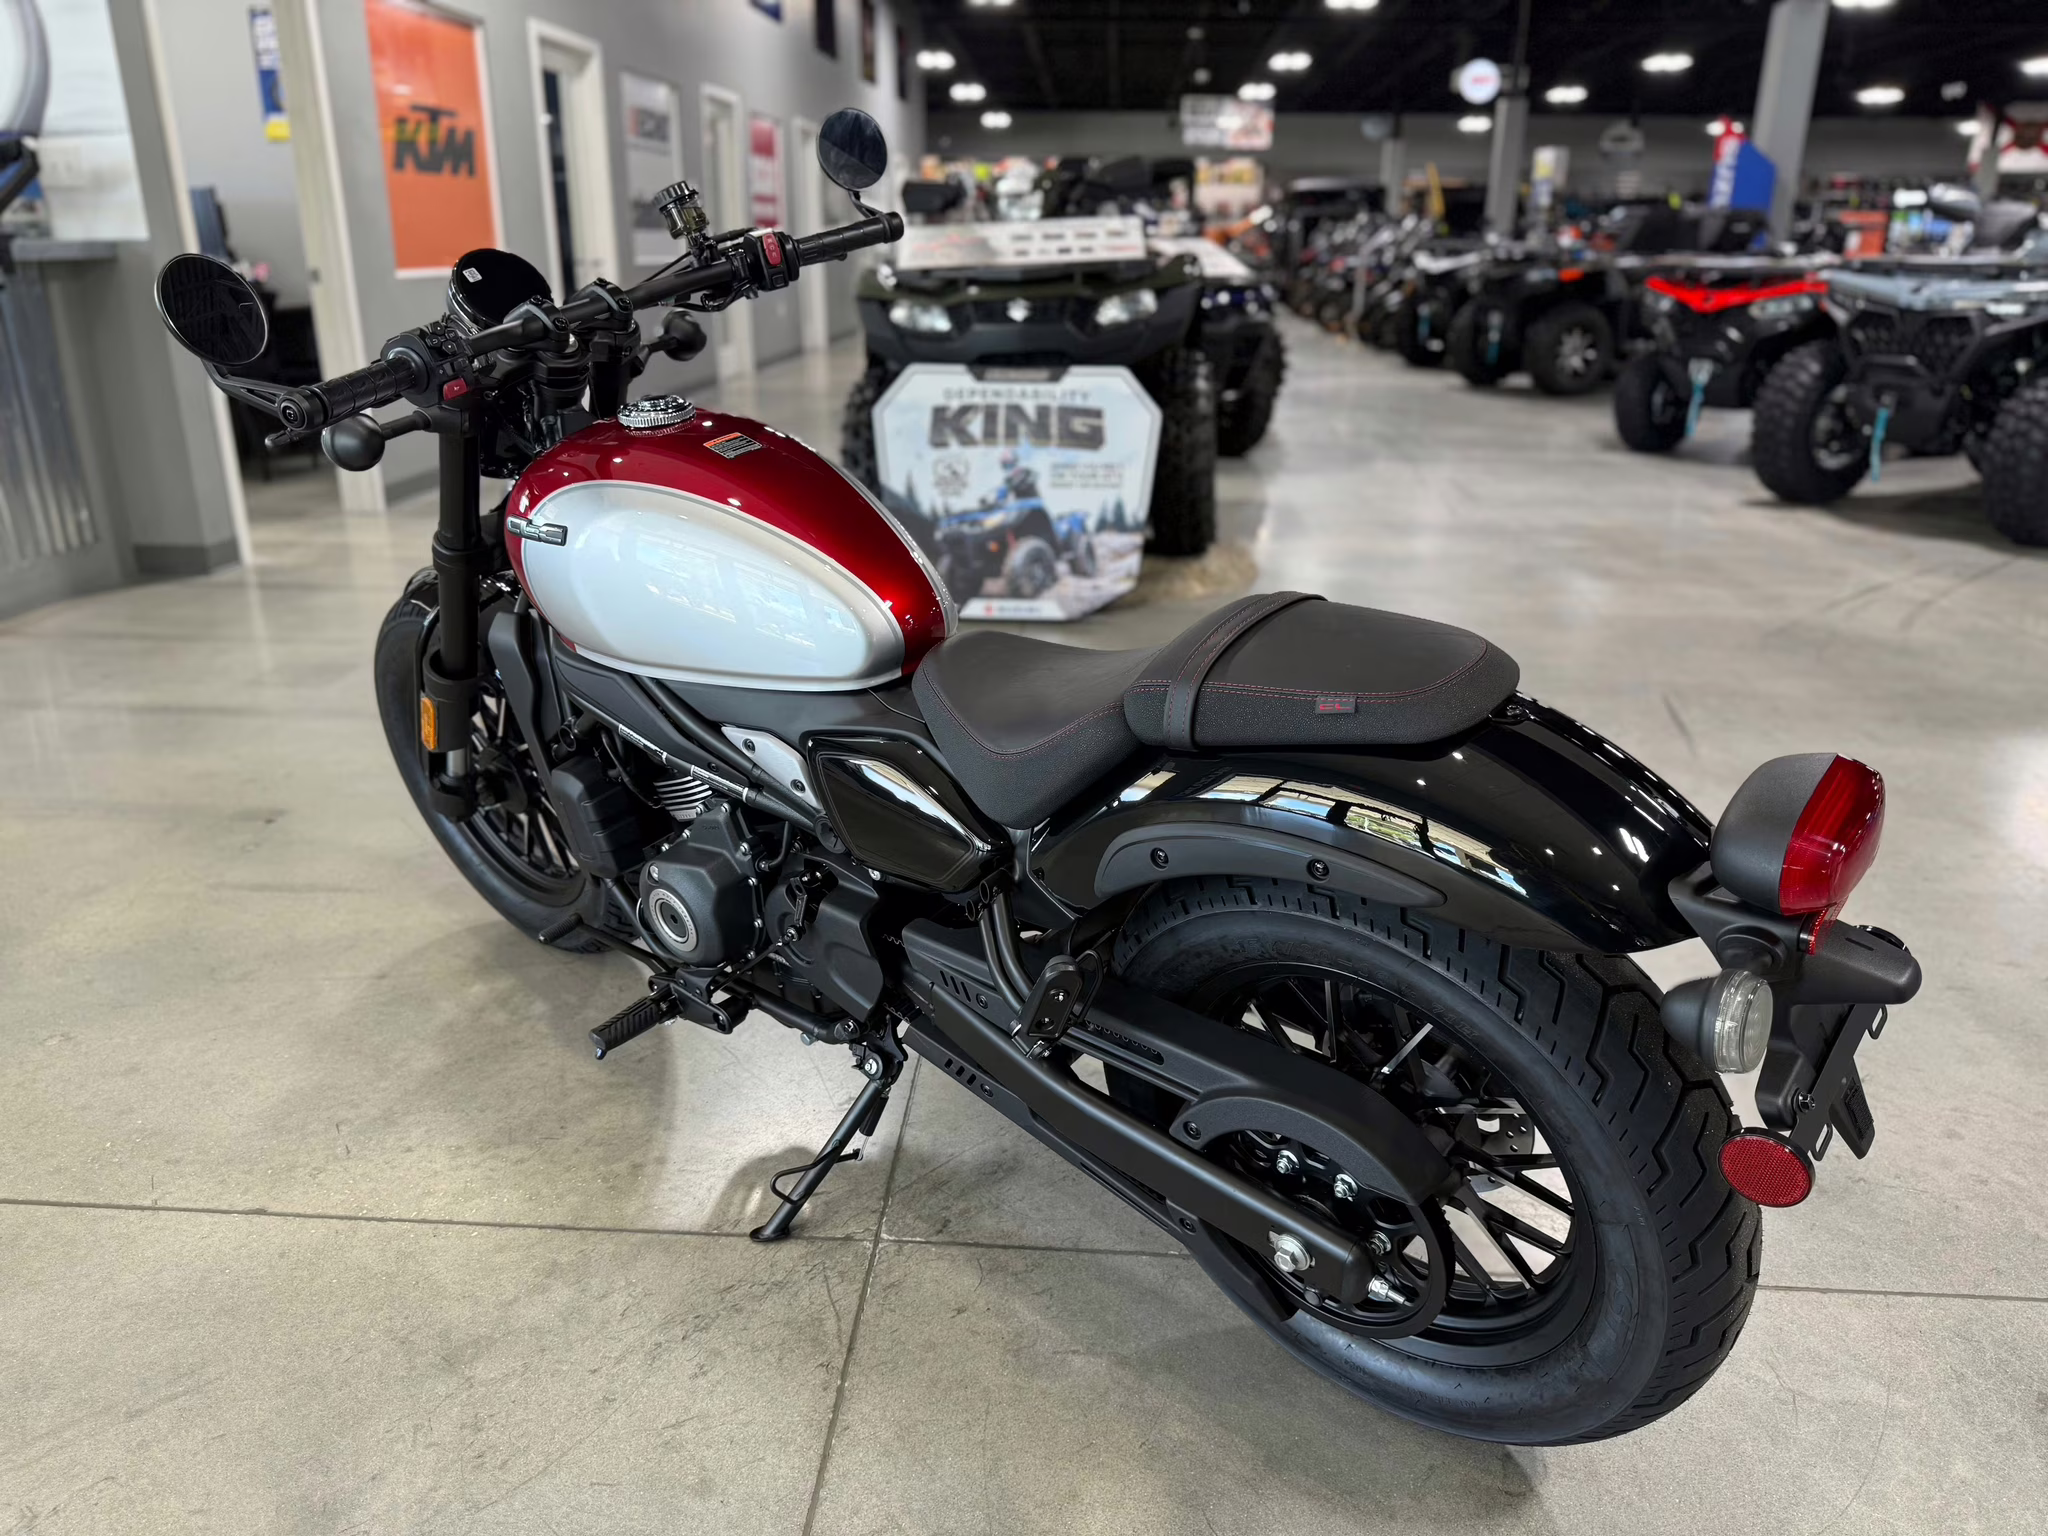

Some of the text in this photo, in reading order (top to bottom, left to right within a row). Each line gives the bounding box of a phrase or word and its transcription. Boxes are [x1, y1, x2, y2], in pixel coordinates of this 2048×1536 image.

[394, 104, 475, 177] KTM
[944, 387, 1091, 402] DEPENDABILITY
[930, 404, 1105, 450] KING
